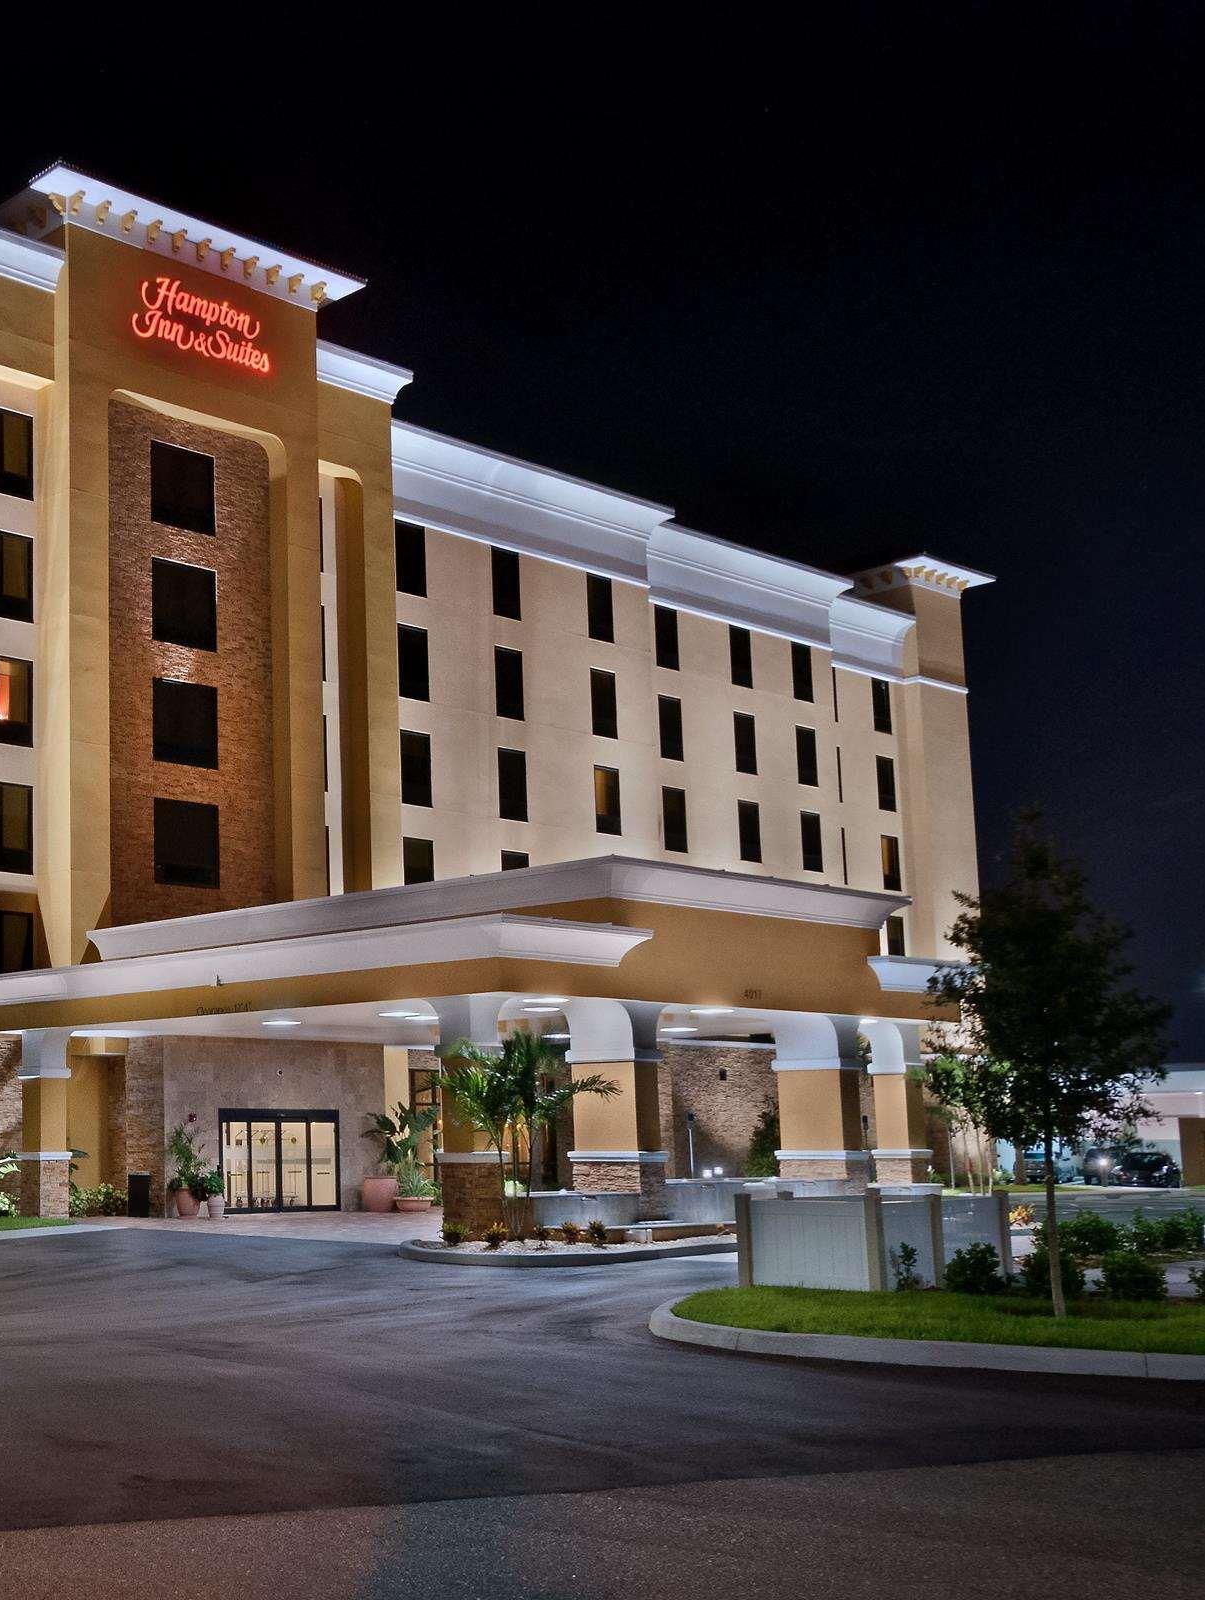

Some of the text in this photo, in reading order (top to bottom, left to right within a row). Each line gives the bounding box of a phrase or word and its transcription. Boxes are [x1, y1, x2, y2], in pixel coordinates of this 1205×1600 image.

[141, 276, 260, 340] Hampton
[131, 310, 270, 373] Inn & Suites
